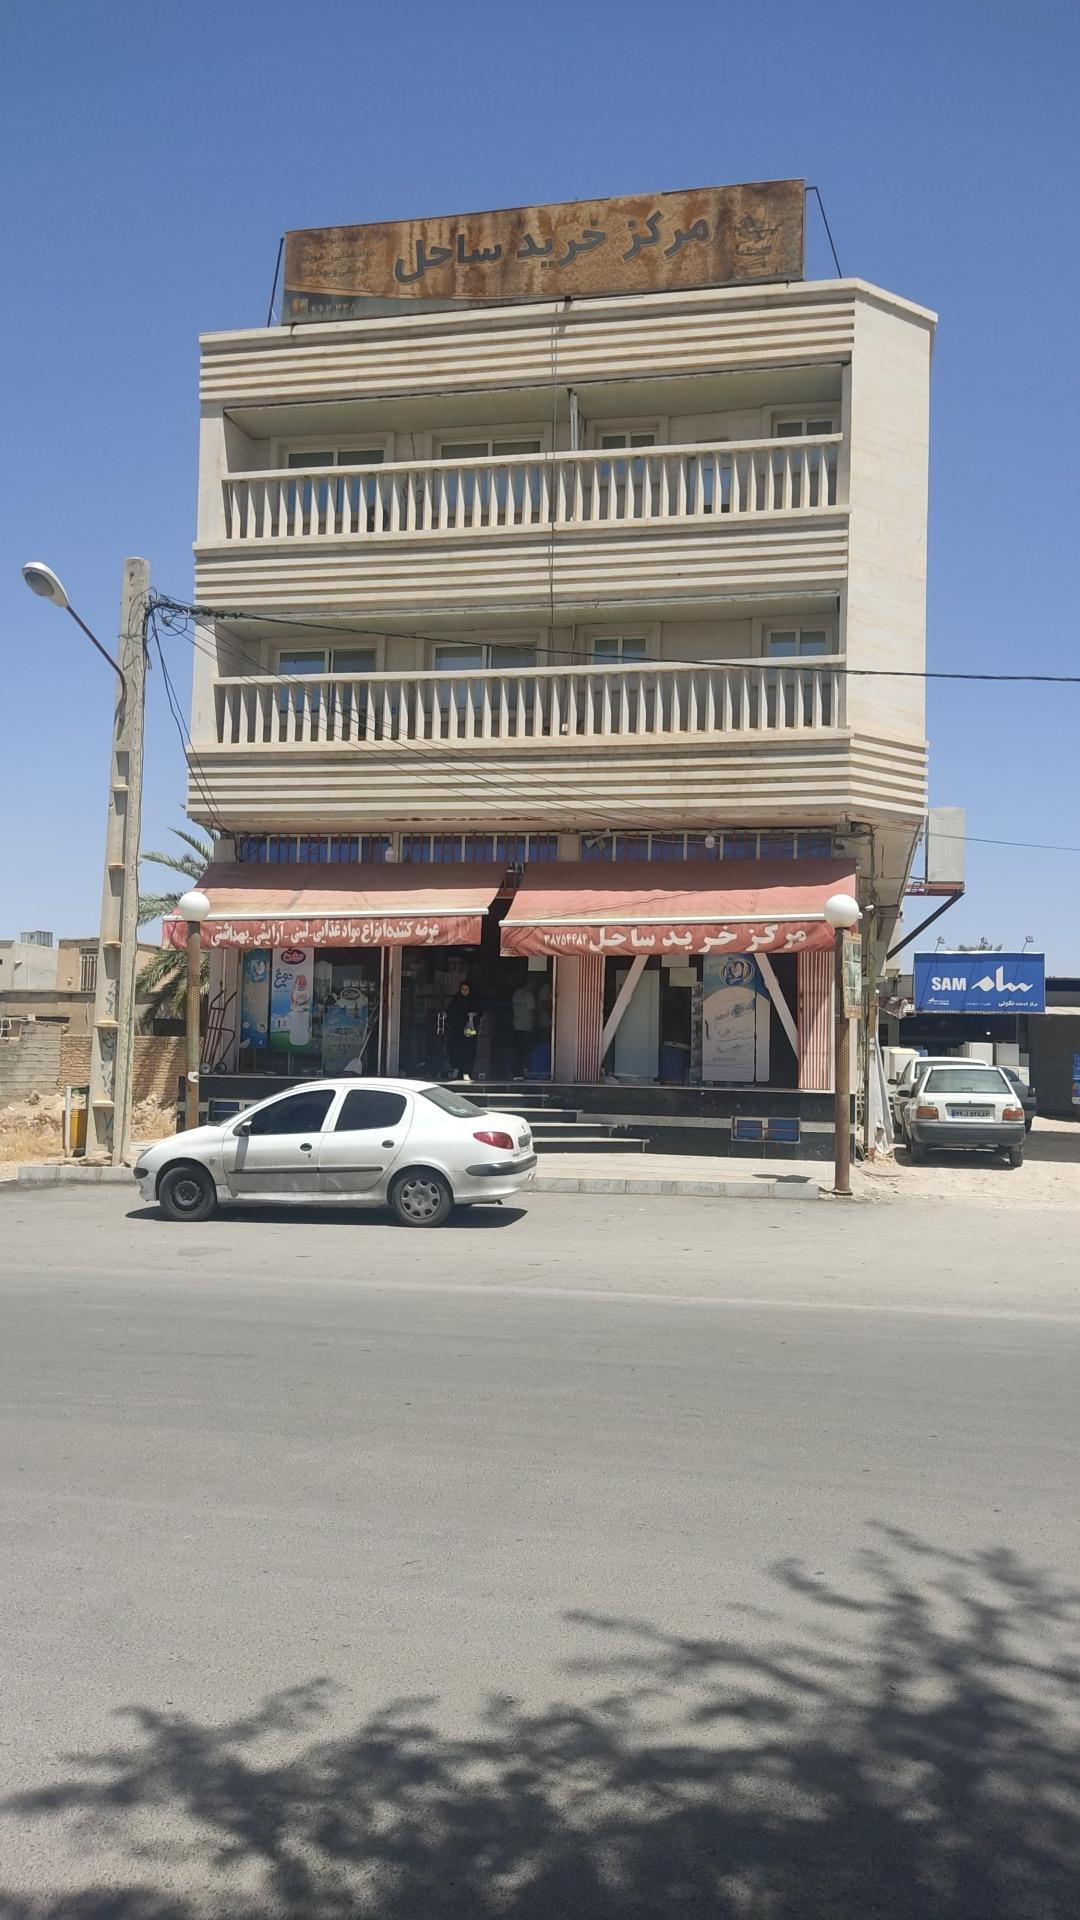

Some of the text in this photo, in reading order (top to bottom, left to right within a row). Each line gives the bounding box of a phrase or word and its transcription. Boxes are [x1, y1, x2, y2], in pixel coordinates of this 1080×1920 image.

[394, 210, 711, 284] مرکز خرید ساحل
[211, 922, 249, 946] بهداشتی
[254, 920, 285, 945] آرایشی
[291, 920, 309, 944] لبنی
[342, 920, 360, 943] مواد
[361, 920, 387, 943] انواع
[387, 921, 413, 938] کننده
[416, 919, 439, 944] عرضه
[589, 927, 655, 951] ساحل
[662, 925, 738, 952] خرید
[745, 923, 806, 951] مرکز
[931, 976, 967, 991] SAM
[971, 965, 1034, 992] سام
